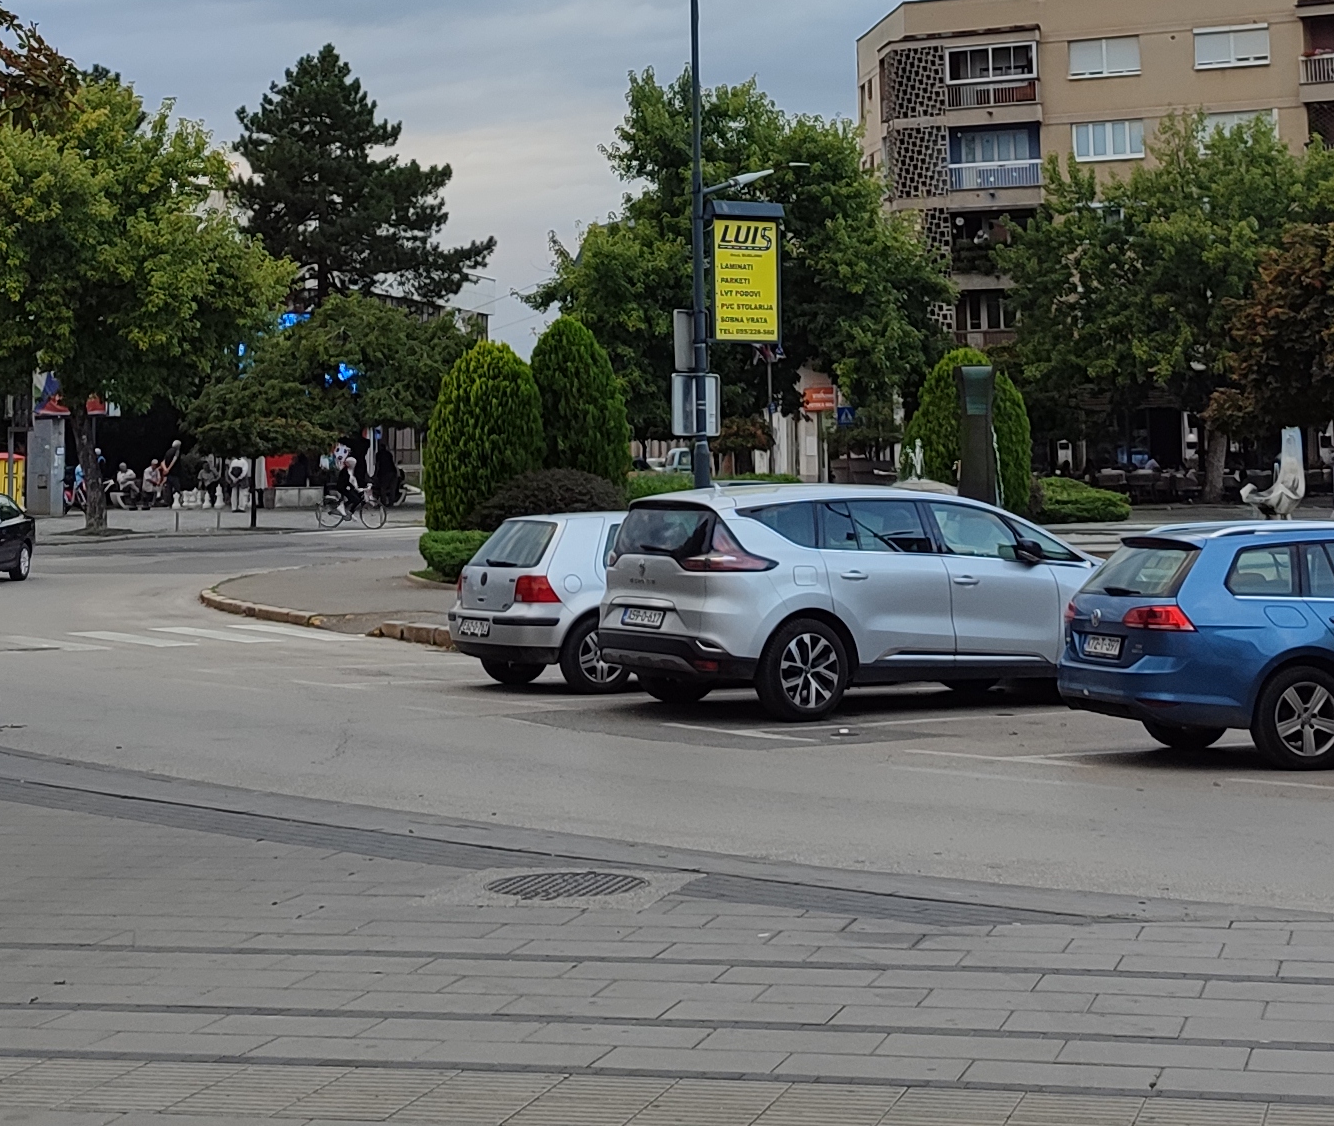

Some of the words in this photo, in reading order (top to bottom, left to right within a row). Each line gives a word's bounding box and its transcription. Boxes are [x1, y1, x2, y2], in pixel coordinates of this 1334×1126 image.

[718, 224, 773, 251] LUIS
[720, 263, 754, 271] LAMINATI
[720, 277, 751, 285] PARKETI
[735, 290, 761, 298] PODOVI
[736, 303, 774, 311] STOLARIJA
[746, 316, 769, 324] VRATA
